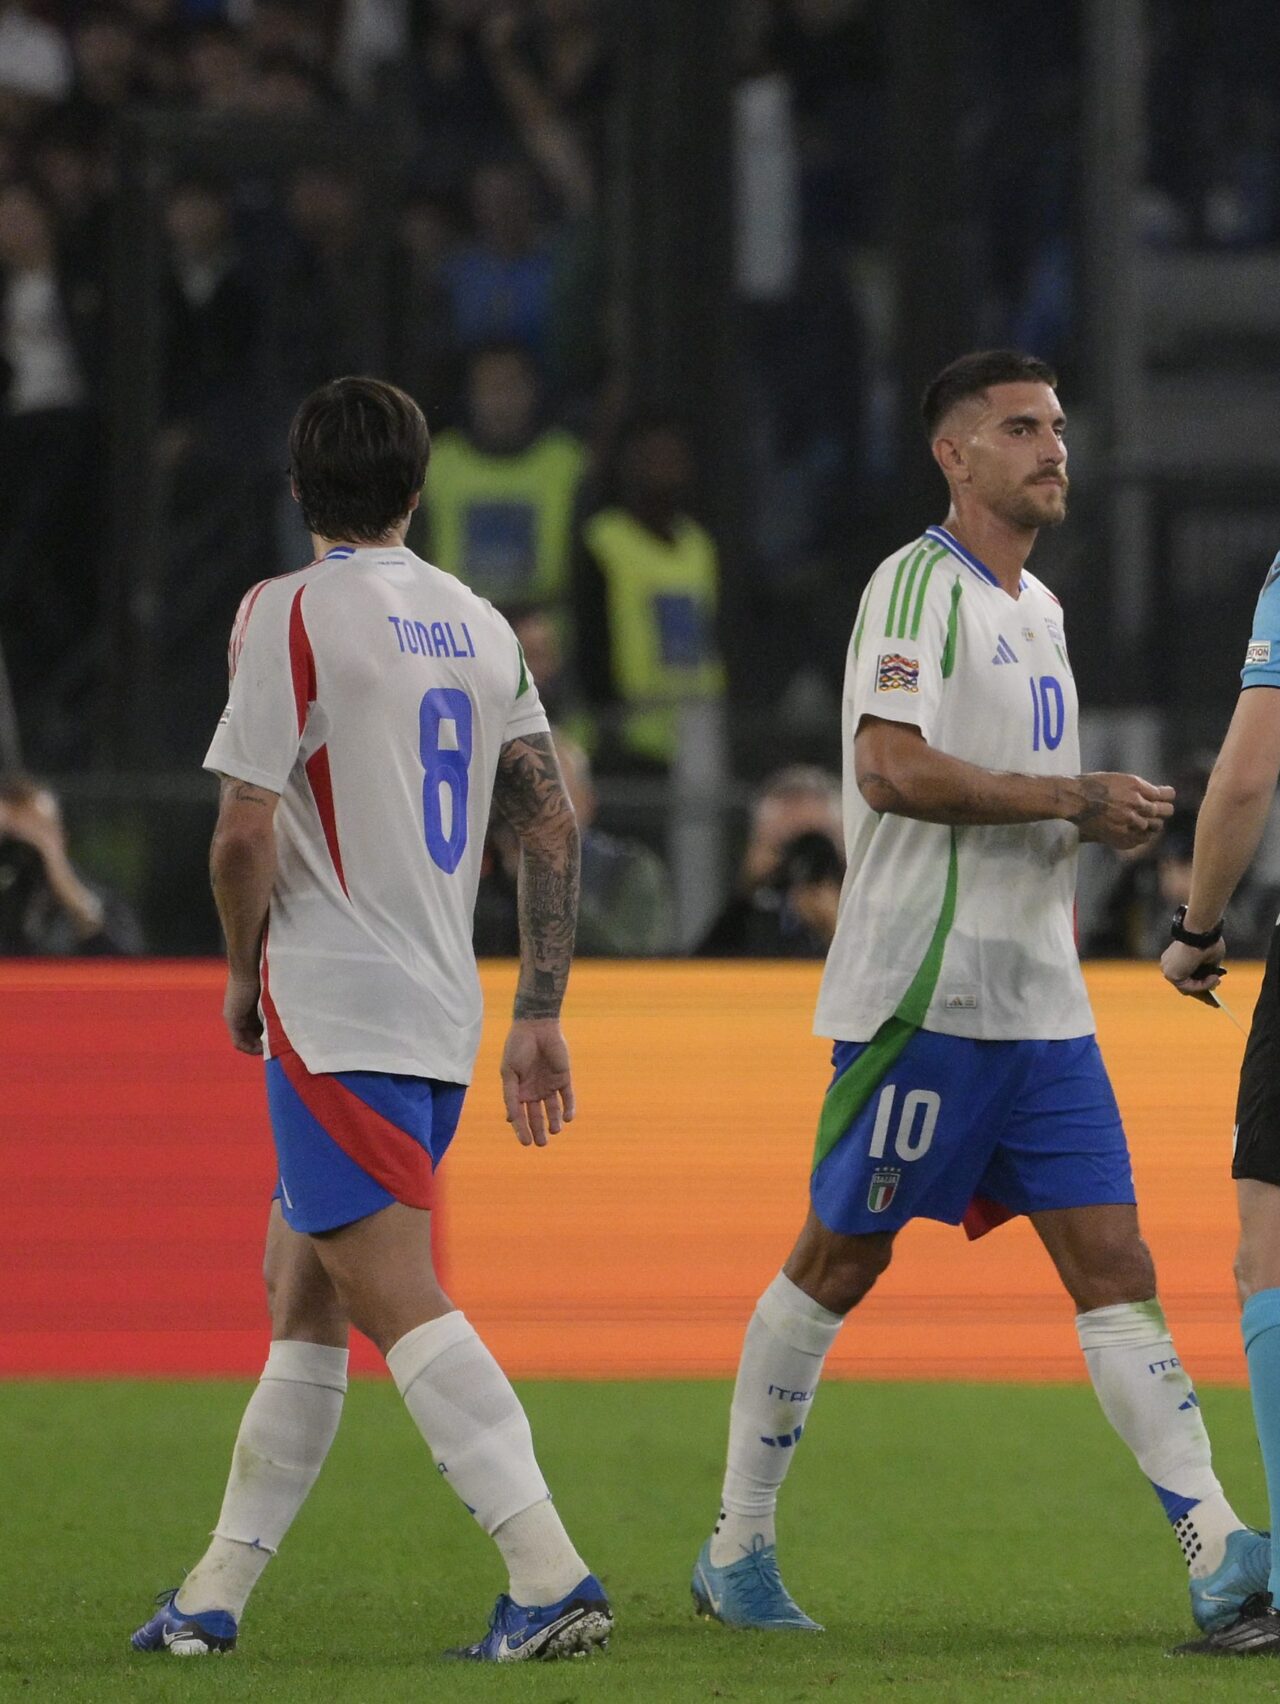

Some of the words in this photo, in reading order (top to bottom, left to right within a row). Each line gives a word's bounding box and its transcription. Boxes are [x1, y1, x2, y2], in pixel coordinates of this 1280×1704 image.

[387, 616, 476, 658] TONALI
[1029, 675, 1065, 752] 10
[419, 687, 473, 875] 8
[868, 1084, 942, 1162] 10
